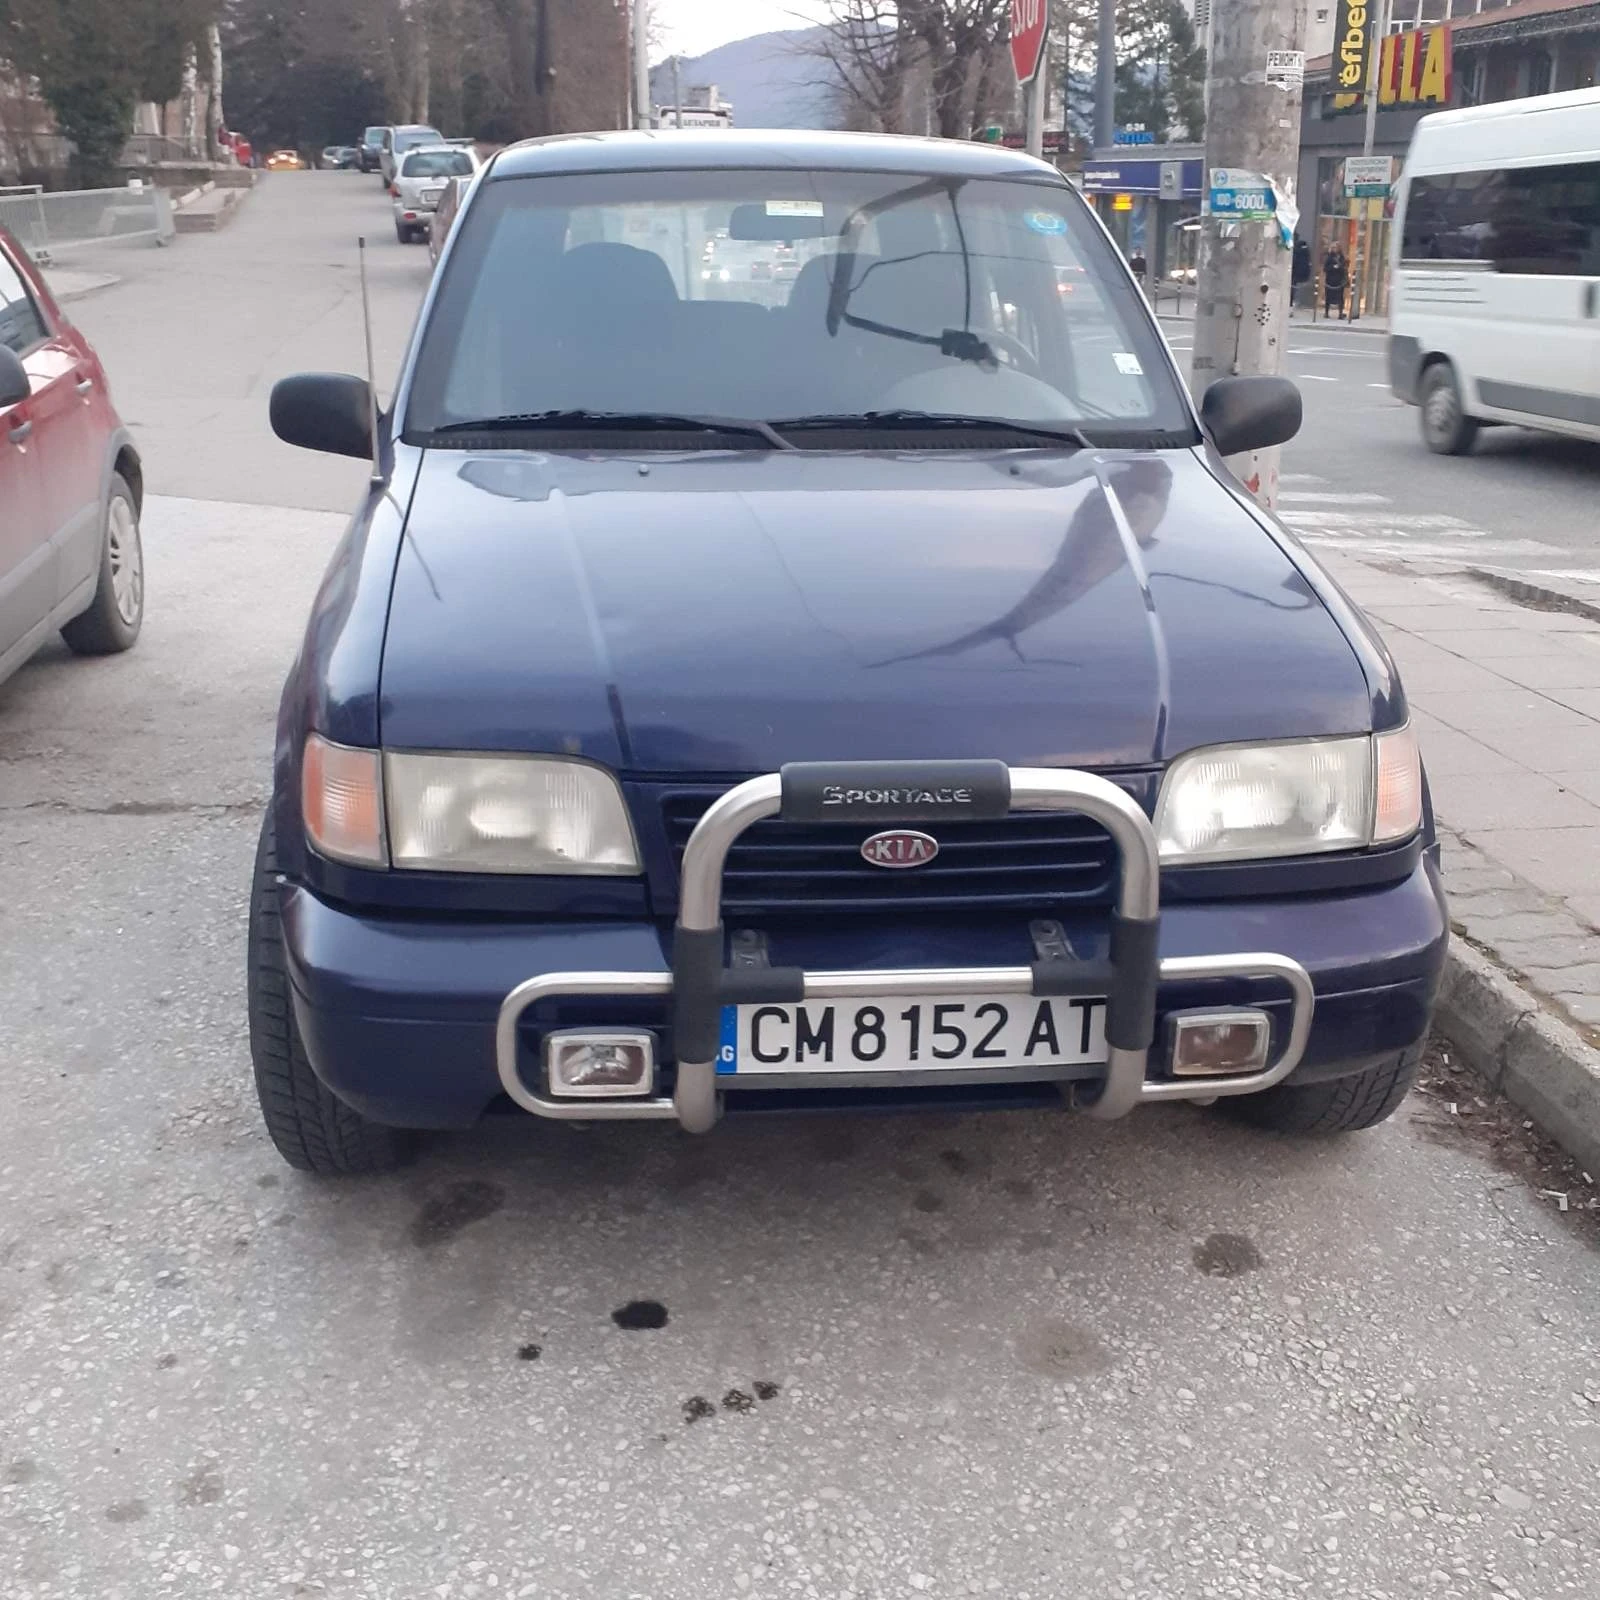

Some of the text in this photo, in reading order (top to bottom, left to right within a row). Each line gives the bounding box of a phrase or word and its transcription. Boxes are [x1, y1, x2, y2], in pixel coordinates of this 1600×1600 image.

[1334, 26, 1447, 108] ILLA
[875, 839, 927, 860] KIA
[852, 1002, 1008, 1062] 8152
